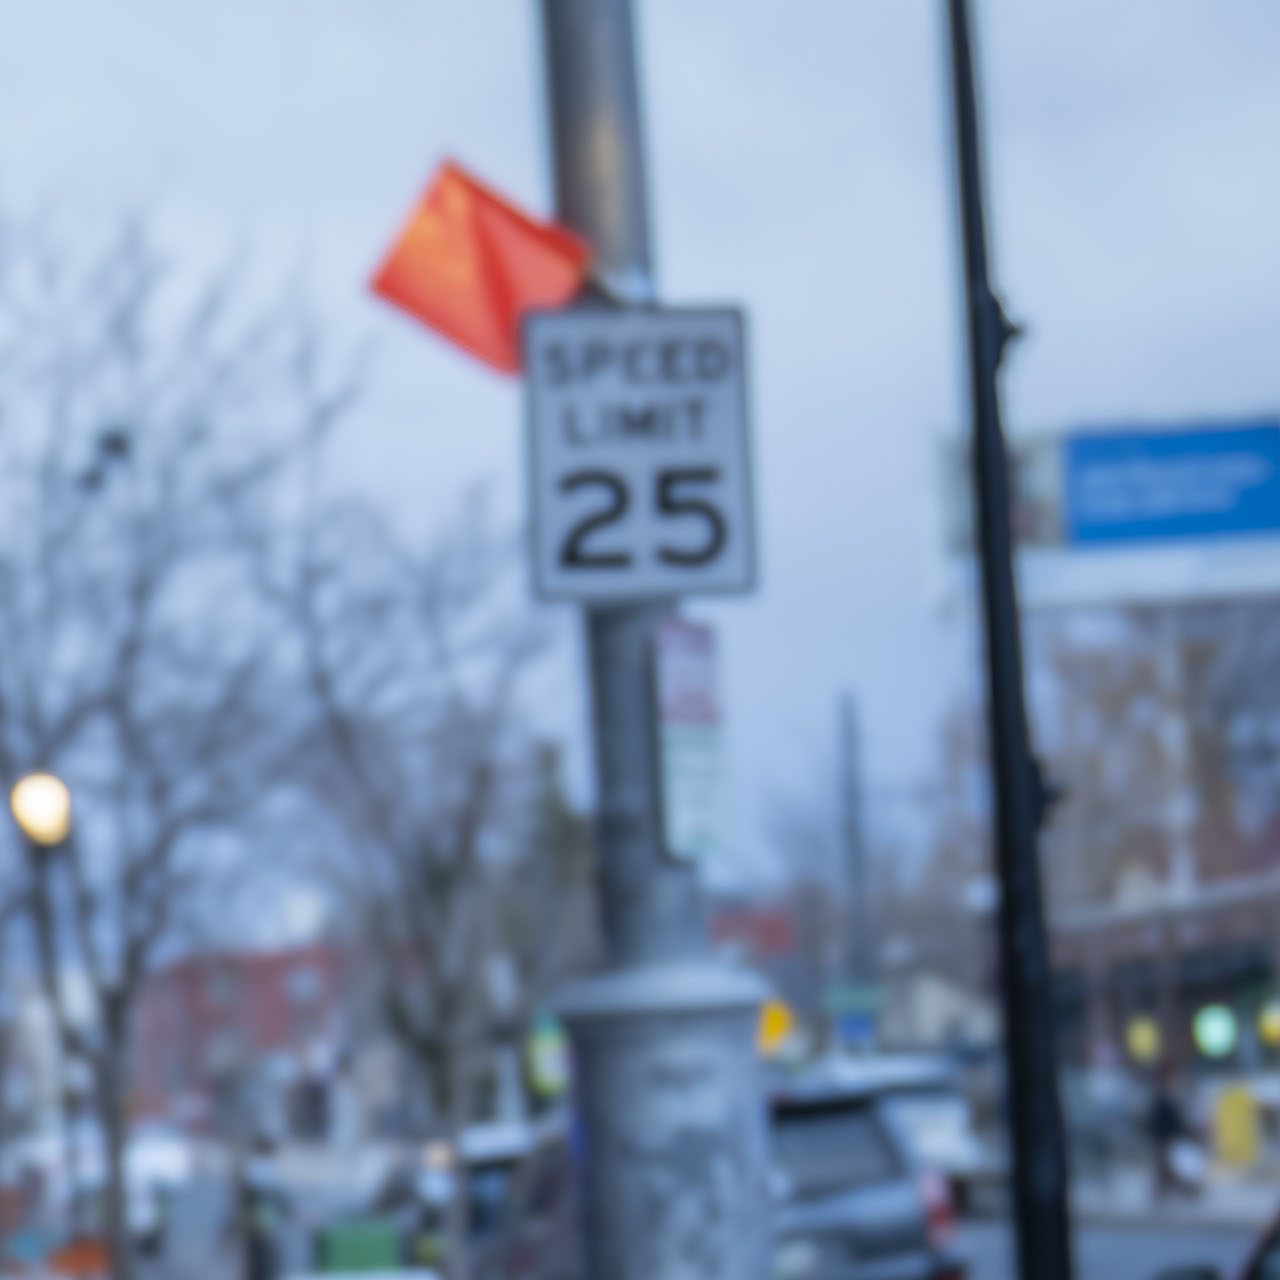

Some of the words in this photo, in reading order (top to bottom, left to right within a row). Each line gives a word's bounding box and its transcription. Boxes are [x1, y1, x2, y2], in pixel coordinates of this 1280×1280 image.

[544, 338, 731, 388] SPEED
[562, 397, 707, 446] LIMIT
[557, 465, 729, 571] 25
